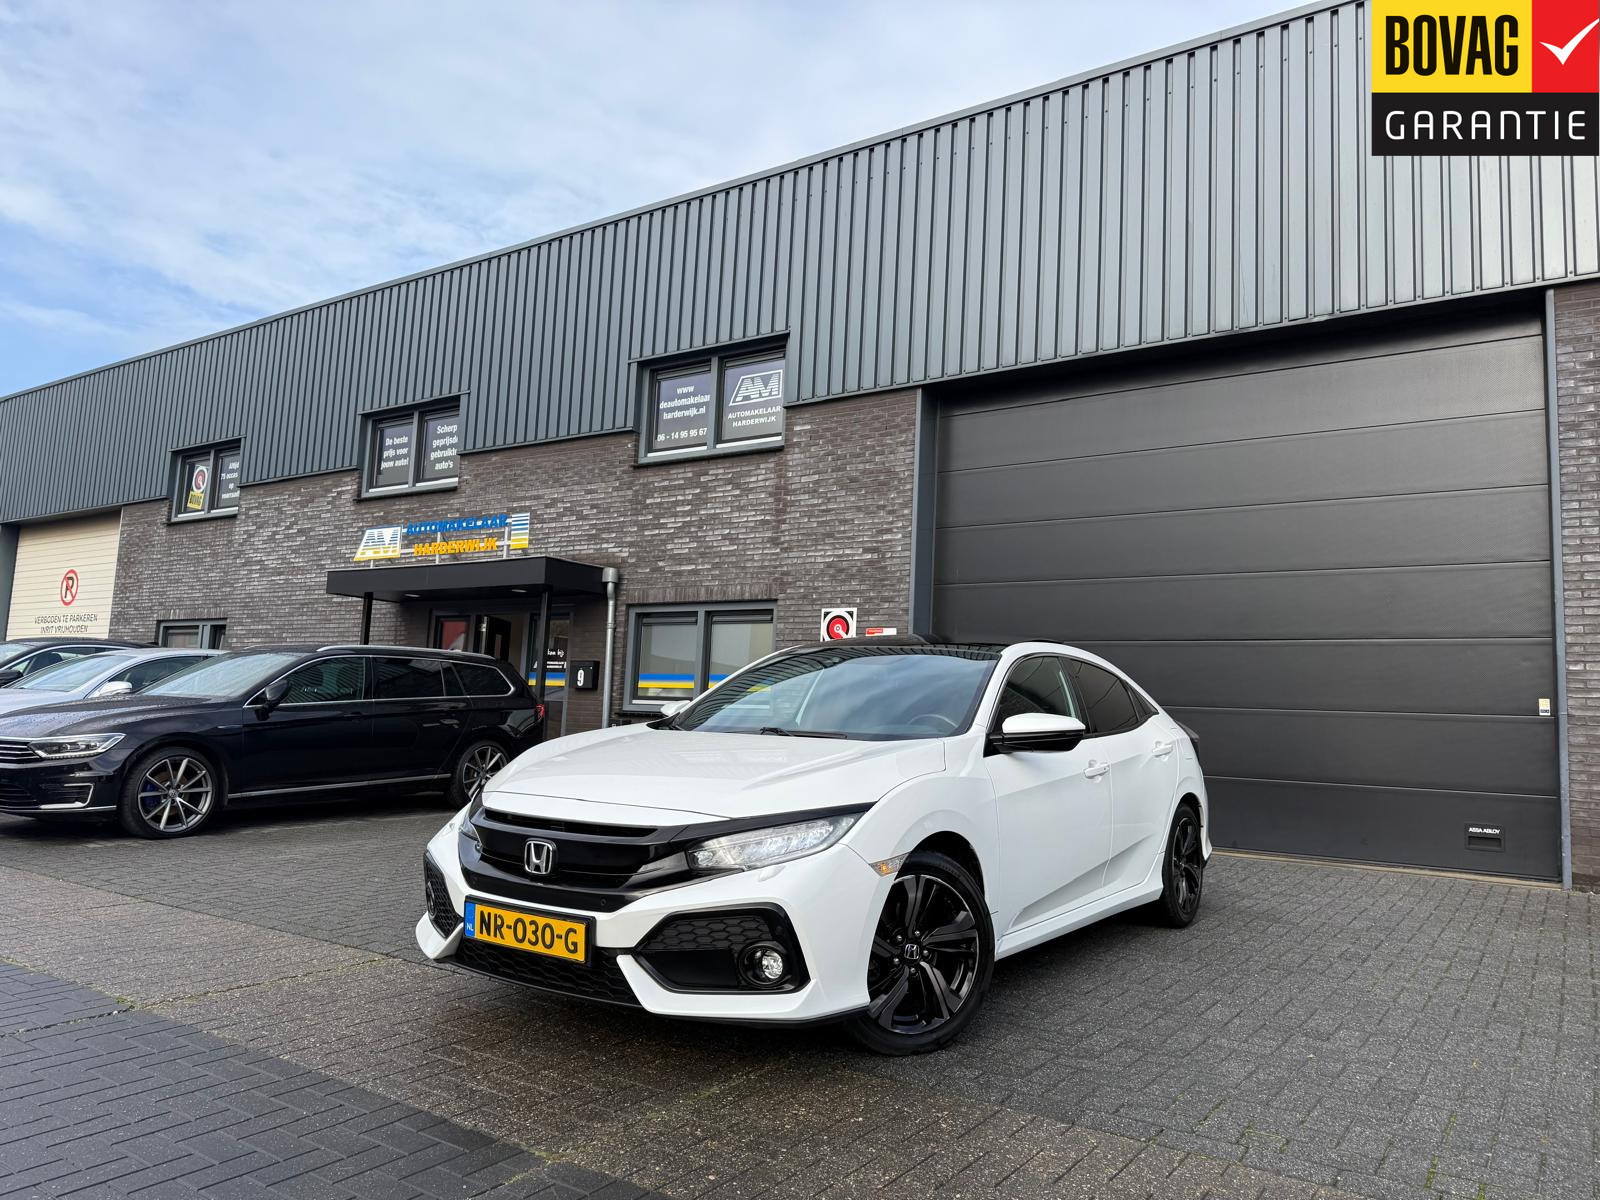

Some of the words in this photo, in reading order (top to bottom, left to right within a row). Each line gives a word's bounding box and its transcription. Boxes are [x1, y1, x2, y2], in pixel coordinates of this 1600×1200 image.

[659, 394, 711, 409] deautomakelaar
[663, 406, 706, 420] harderwijk.nl
[728, 405, 781, 419] AUTOMAKELAAR
[437, 424, 458, 434] Scherp
[732, 416, 777, 428] HARDERWIJK
[385, 437, 393, 446] De
[393, 435, 409, 445] beste
[657, 433, 666, 442] 06
[671, 432, 679, 440] 14
[680, 430, 689, 439] 95
[689, 429, 698, 438] 95
[699, 428, 708, 436] 67
[383, 448, 396, 459] prijs
[396, 447, 409, 455] voor
[406, 514, 509, 535] AUTOMAKELAAR
[414, 538, 498, 556] HARDERWIJK
[34, 615, 61, 624] VERBODEN
[62, 614, 69, 623] TE
[69, 613, 98, 623] PARKEREN
[577, 669, 585, 686] 9
[466, 922, 474, 932] NL
[479, 910, 578, 954] NR-030-G
